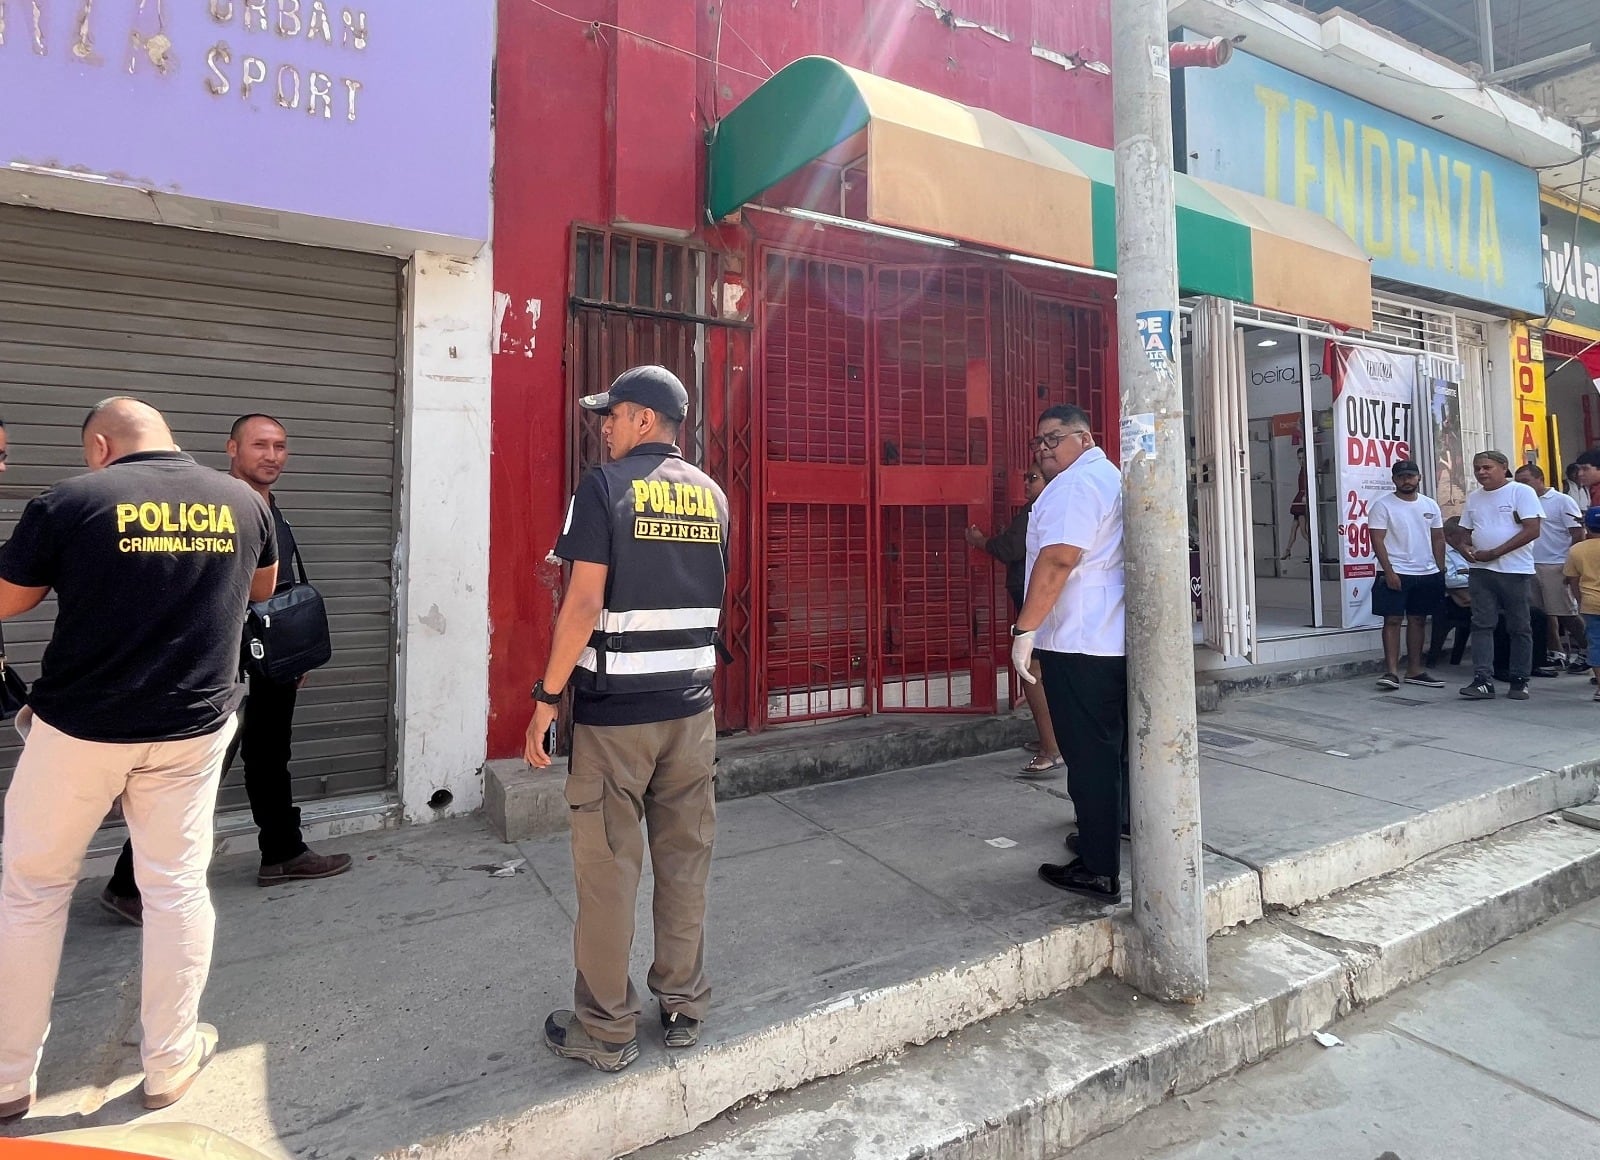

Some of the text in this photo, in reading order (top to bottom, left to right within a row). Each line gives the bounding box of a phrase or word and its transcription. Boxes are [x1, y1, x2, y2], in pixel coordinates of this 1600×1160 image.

[206, 43, 363, 121] SPORT
[1254, 85, 1503, 286] TENDENZA
[1541, 233, 1600, 304] ulla
[1252, 366, 1295, 386] beira
[1346, 395, 1412, 441] OUTLET
[1516, 336, 1535, 464] DOLA
[1347, 437, 1410, 468] DAYS
[632, 480, 718, 519] POLICIA
[638, 521, 717, 540] DEPINCRI
